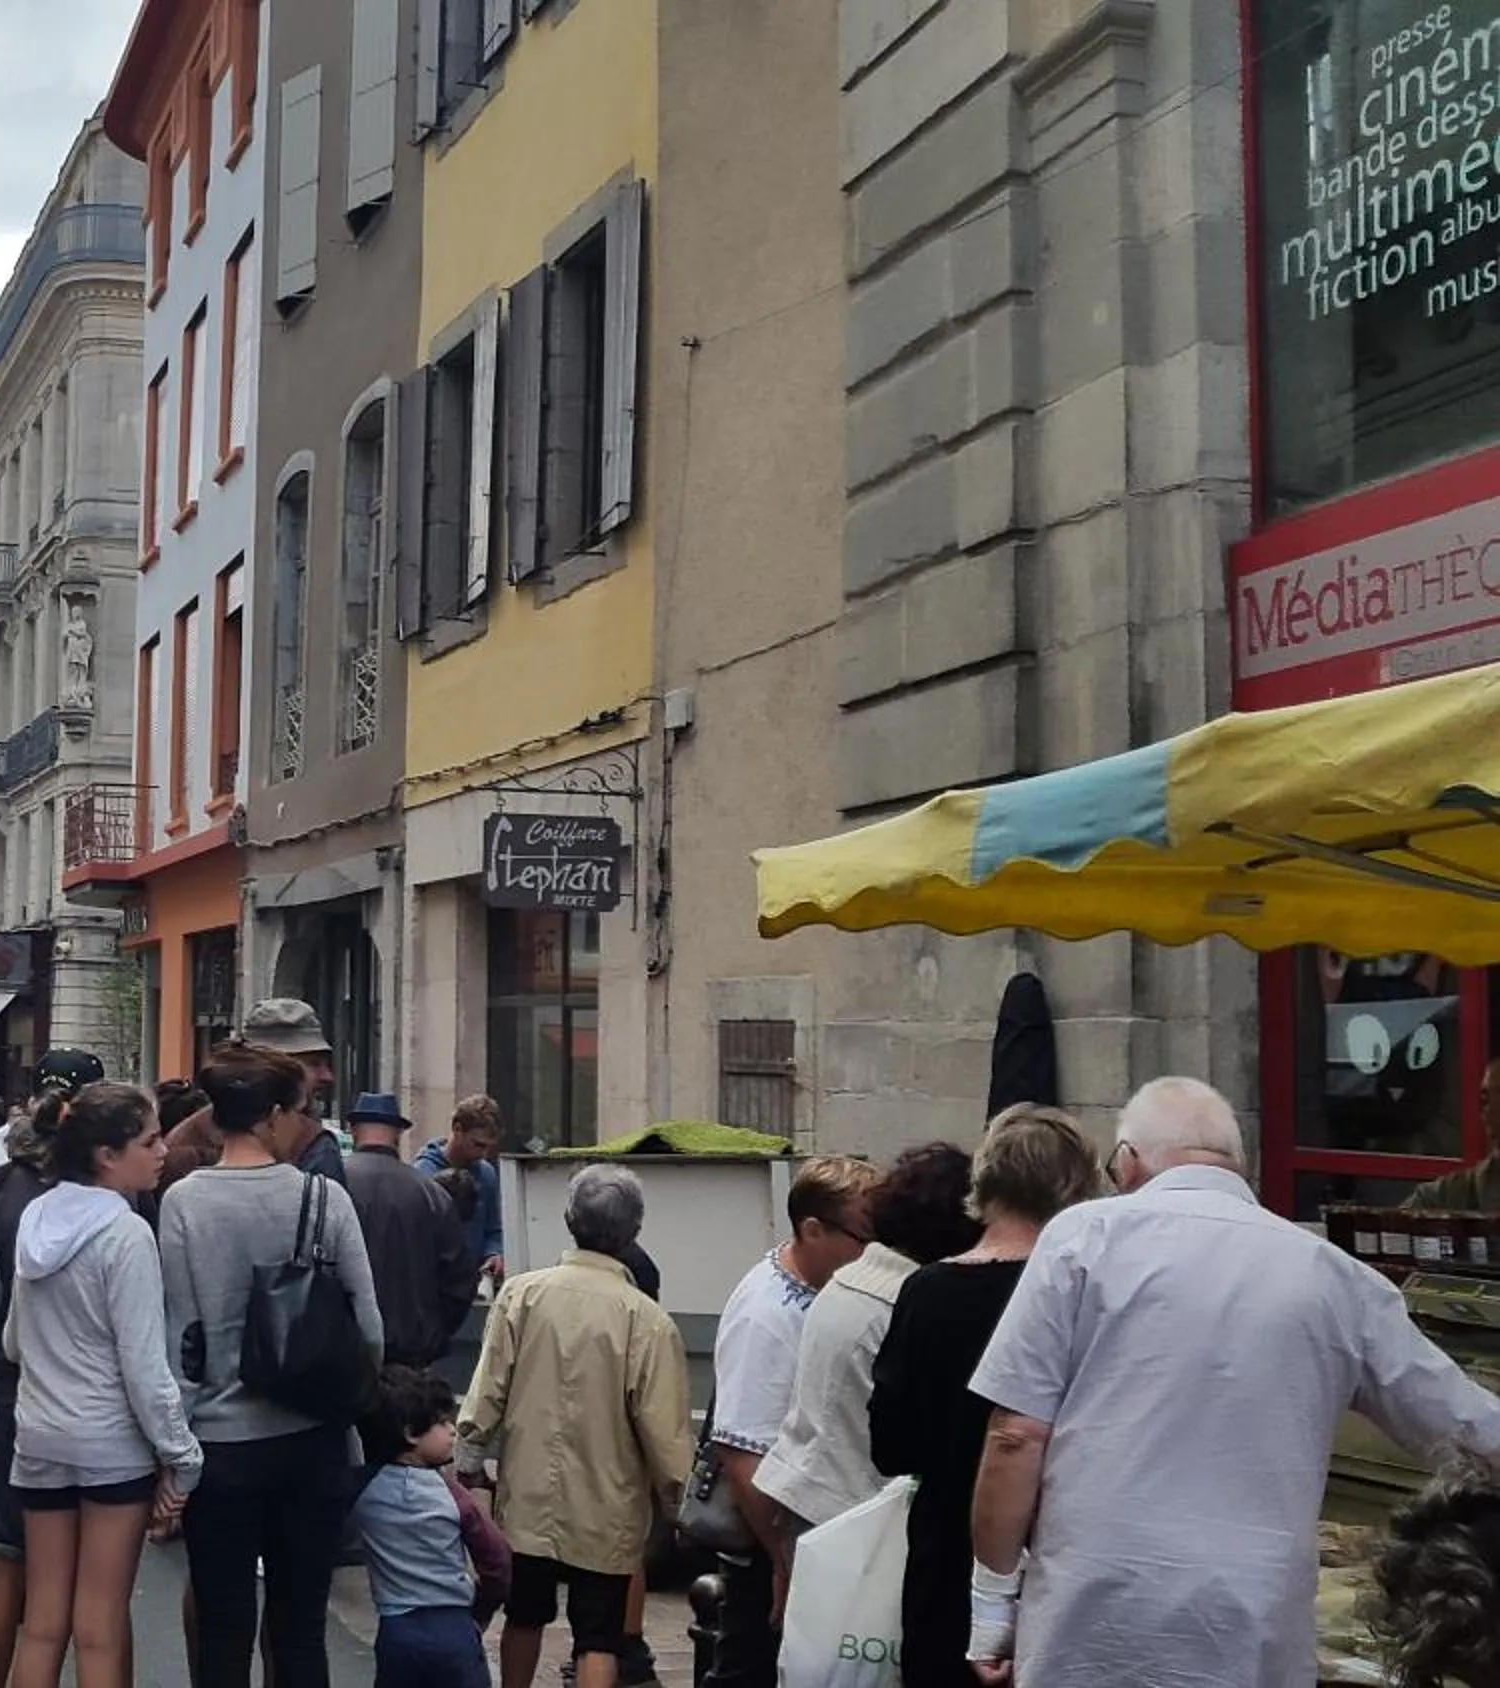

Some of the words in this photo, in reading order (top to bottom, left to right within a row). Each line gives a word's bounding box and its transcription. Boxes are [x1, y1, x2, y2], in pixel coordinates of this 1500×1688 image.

[1370, 4, 1451, 78] presse
[1307, 128, 1406, 208] bande
[1308, 230, 1435, 321] fiction
[525, 818, 608, 847] Coiffure
